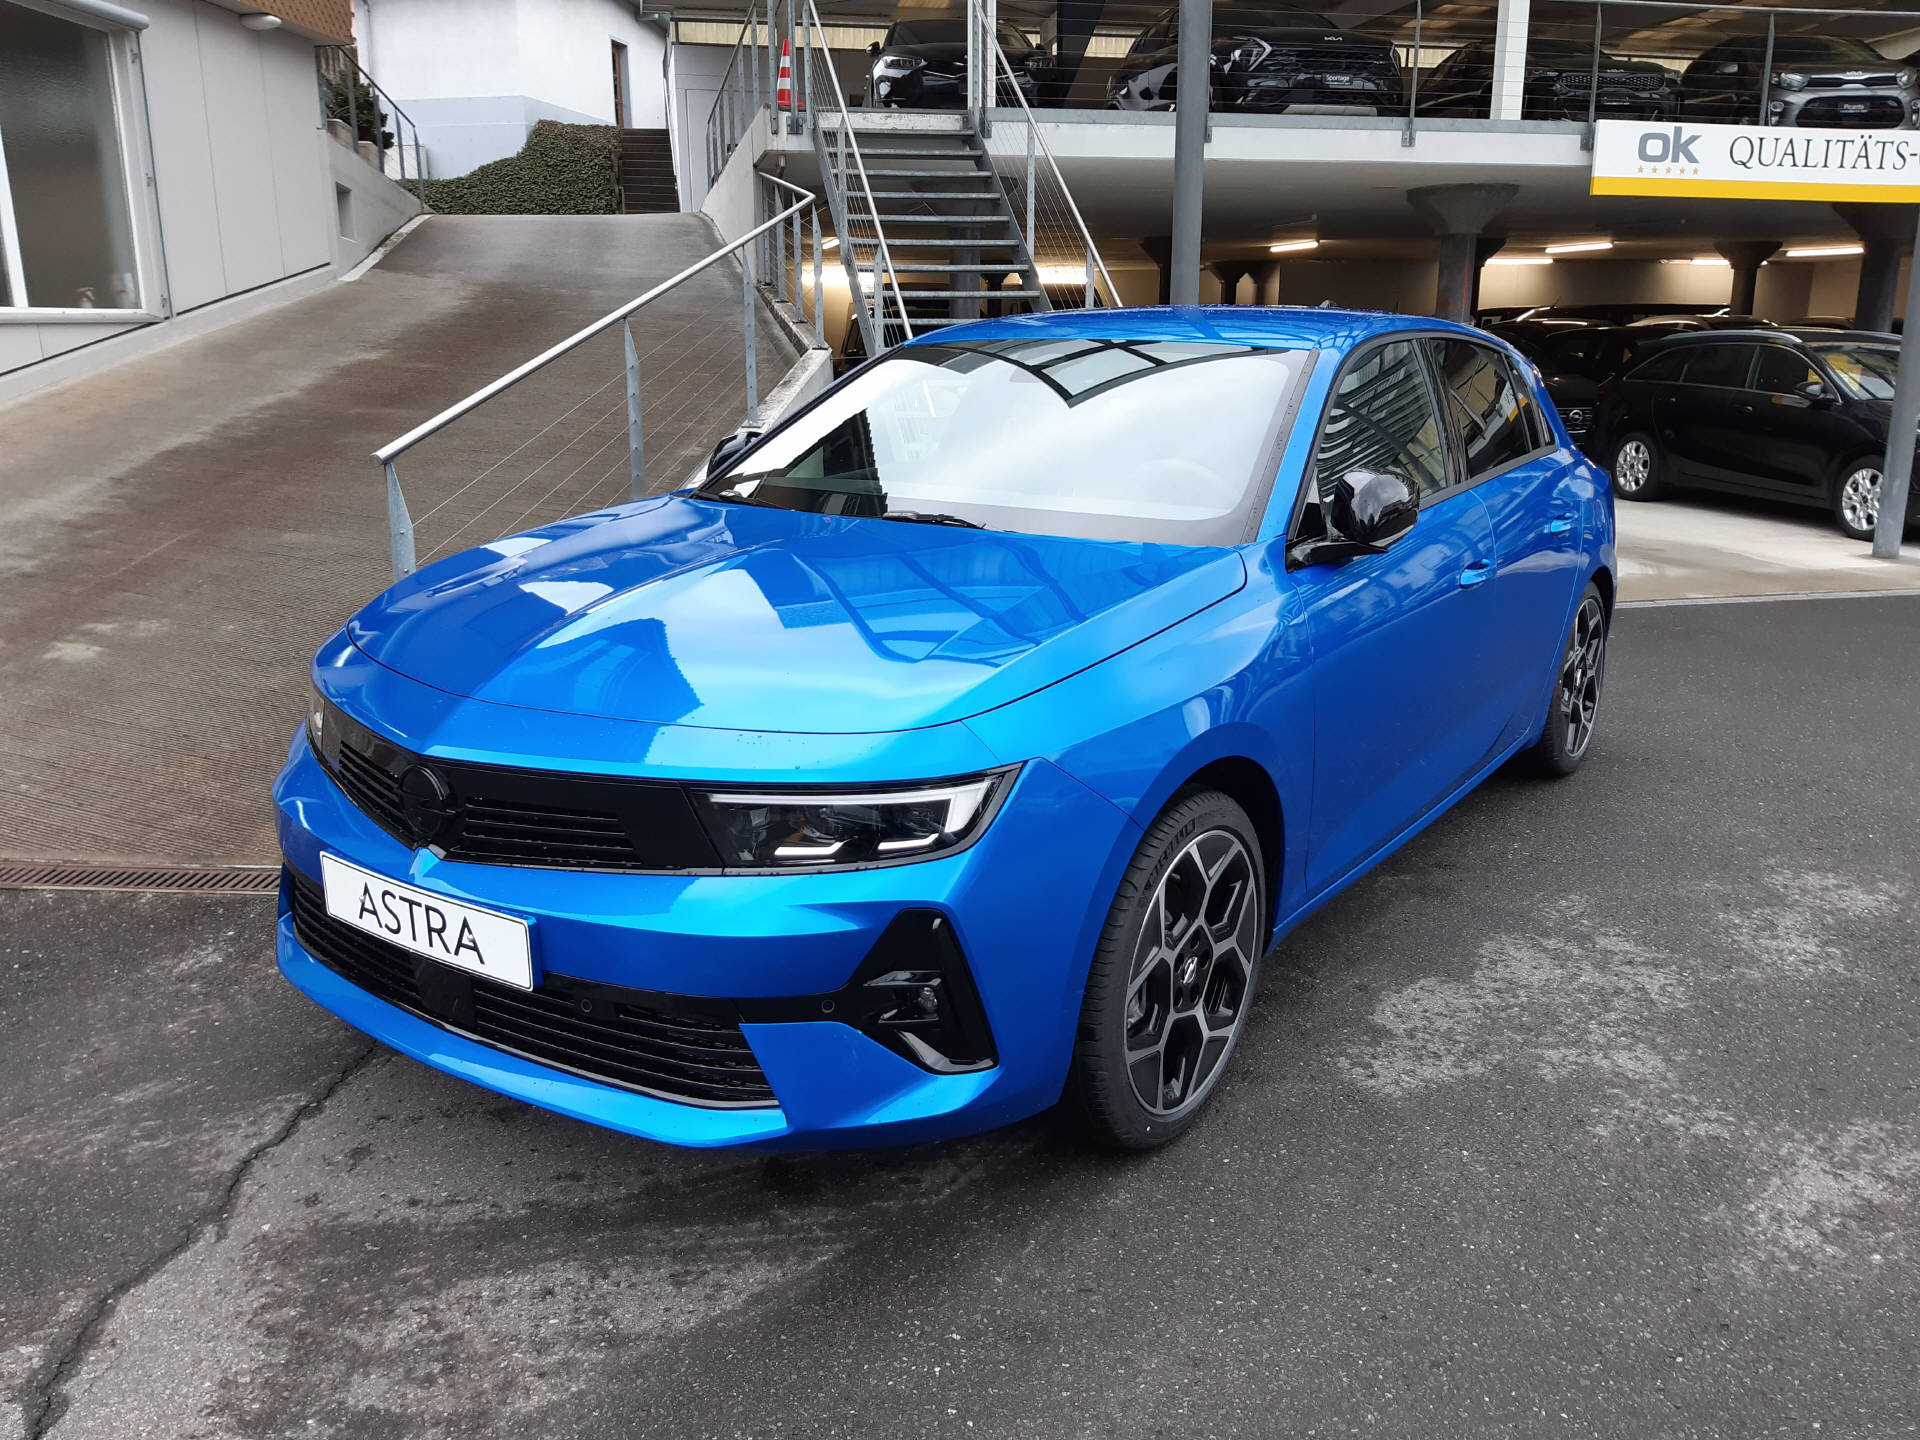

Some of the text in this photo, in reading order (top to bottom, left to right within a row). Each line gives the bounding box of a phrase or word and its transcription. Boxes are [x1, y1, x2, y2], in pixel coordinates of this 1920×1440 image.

[1637, 126, 1702, 164] ok
[1729, 134, 1918, 171] QUALITÄTS-
[358, 881, 486, 965] ASTRA
